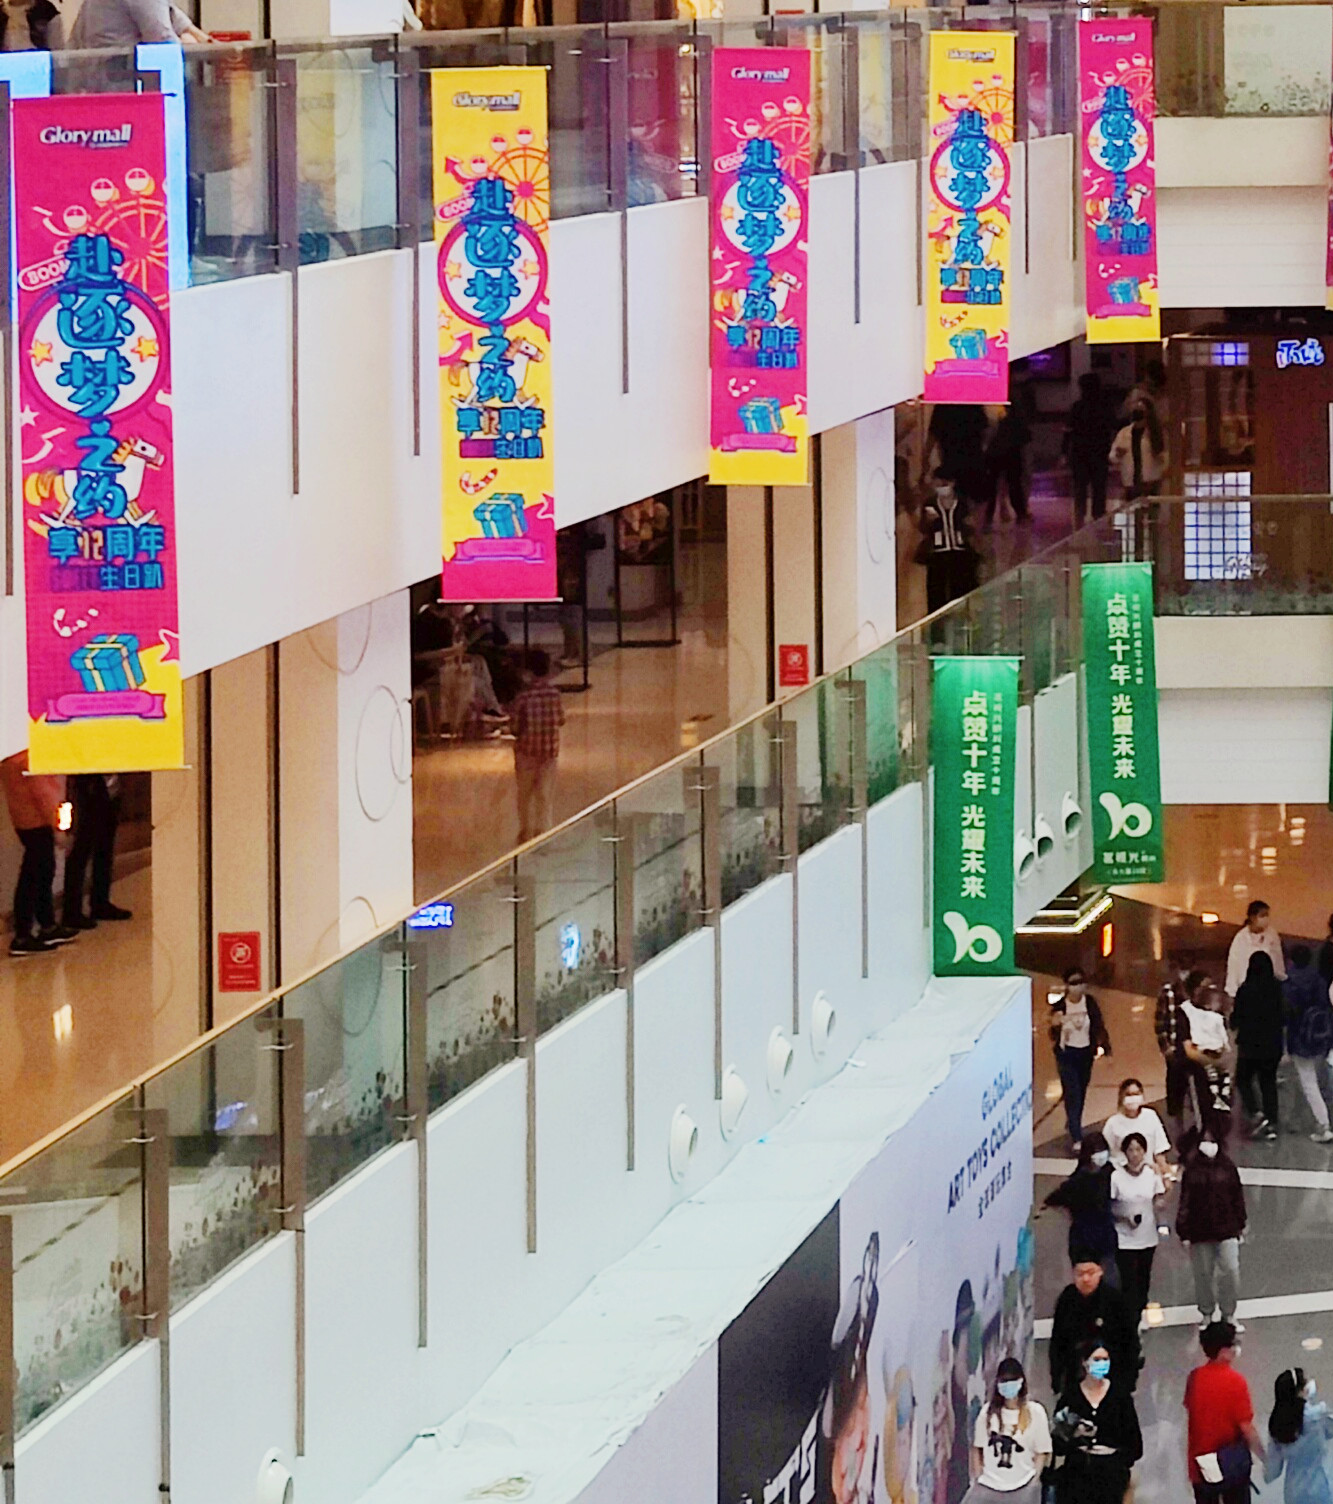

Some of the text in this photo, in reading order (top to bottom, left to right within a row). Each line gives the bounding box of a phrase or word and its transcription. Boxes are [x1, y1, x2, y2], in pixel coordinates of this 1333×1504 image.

[1106, 593, 1132, 686] 点赞十年
[962, 690, 988, 796] 点赞十年
